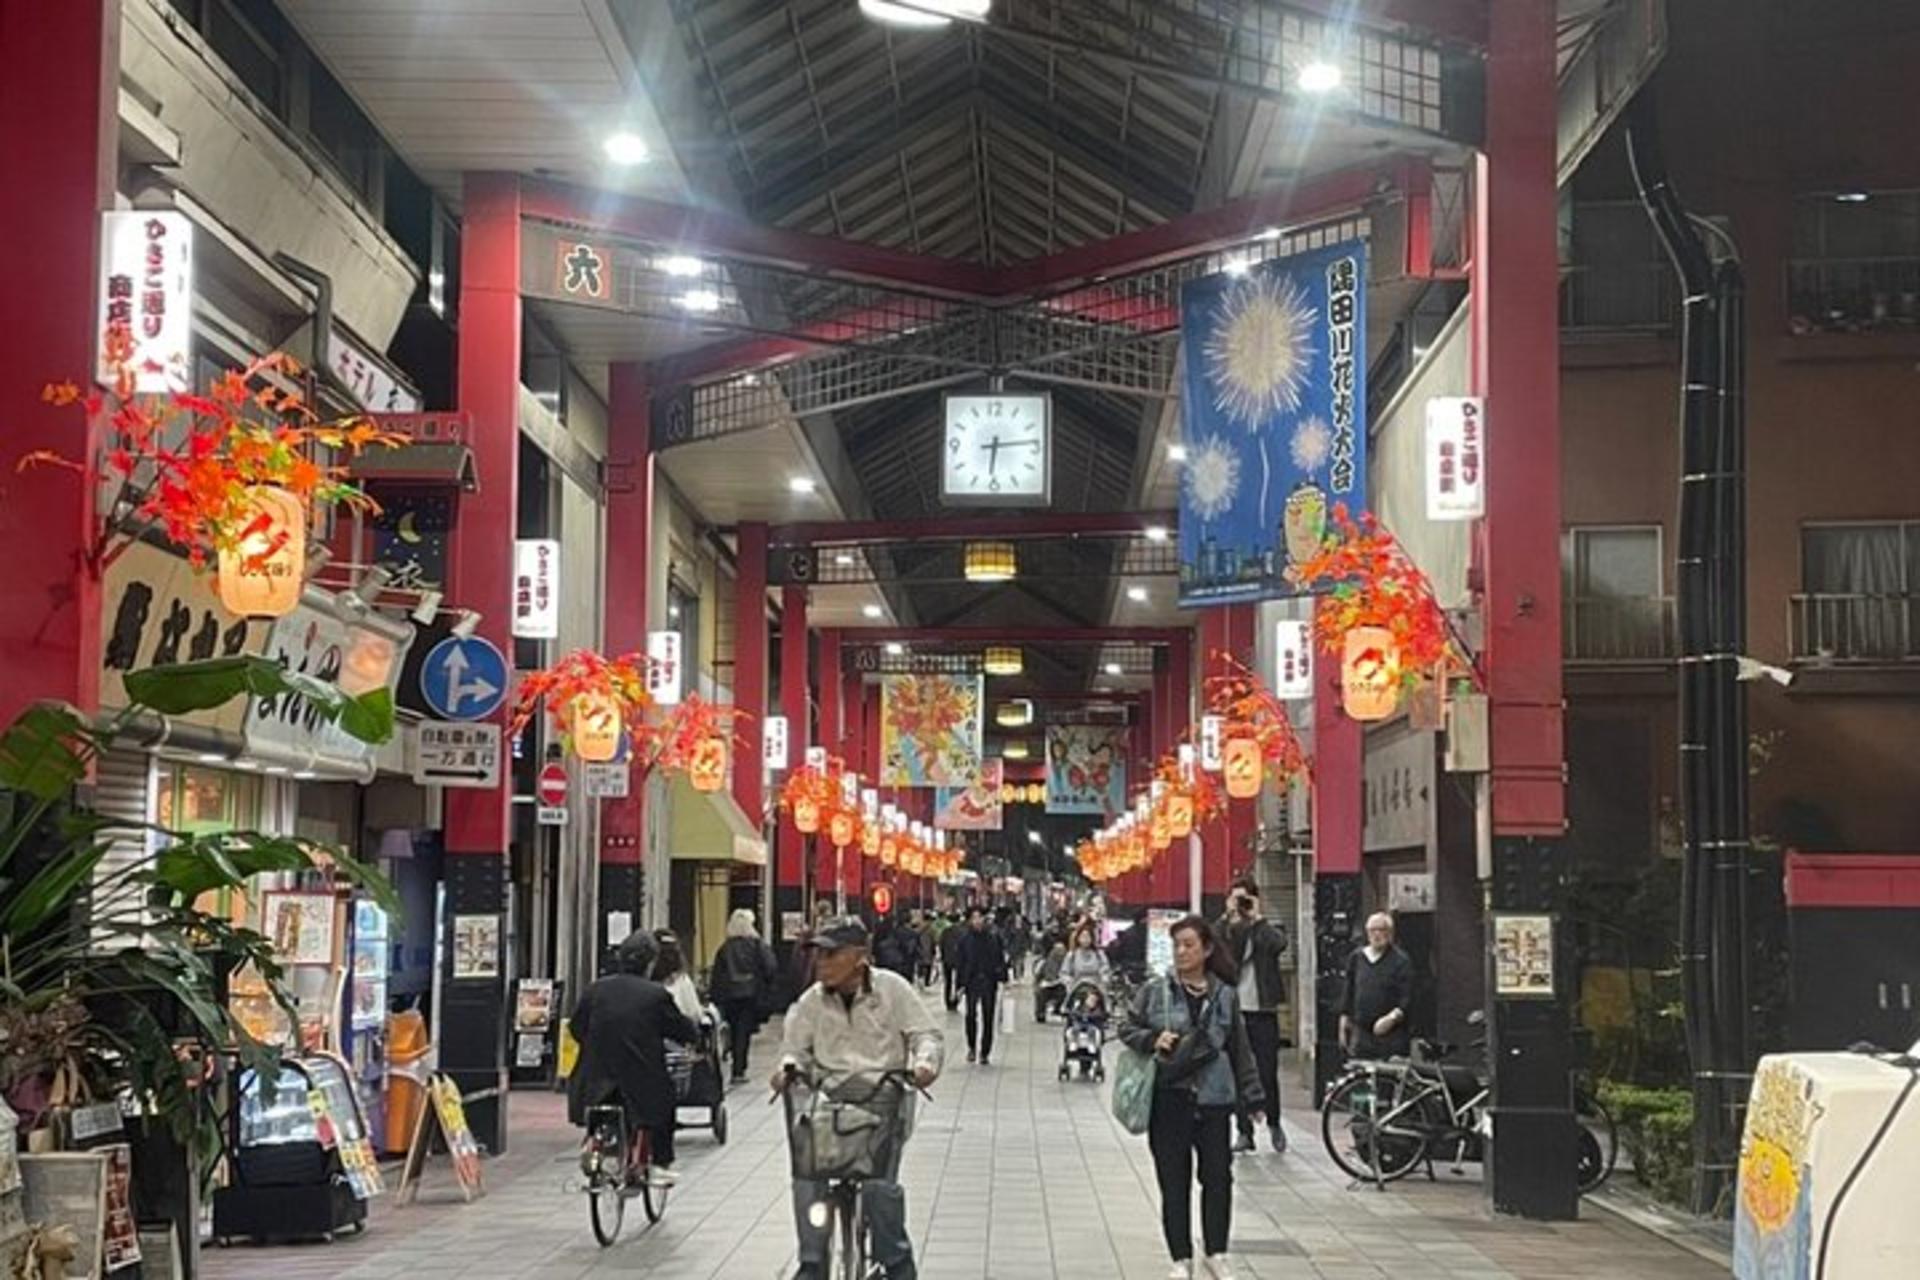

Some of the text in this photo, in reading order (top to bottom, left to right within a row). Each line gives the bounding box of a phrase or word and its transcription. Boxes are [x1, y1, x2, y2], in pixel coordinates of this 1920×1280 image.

[143, 219, 166, 338] ひさご通り
[566, 245, 602, 296] 六
[1328, 257, 1356, 492] 隅田川花火大会
[987, 401, 1002, 416] 12
[949, 438, 960, 454] 9
[989, 477, 1000, 491] 6
[421, 751, 494, 767] 一方通行
